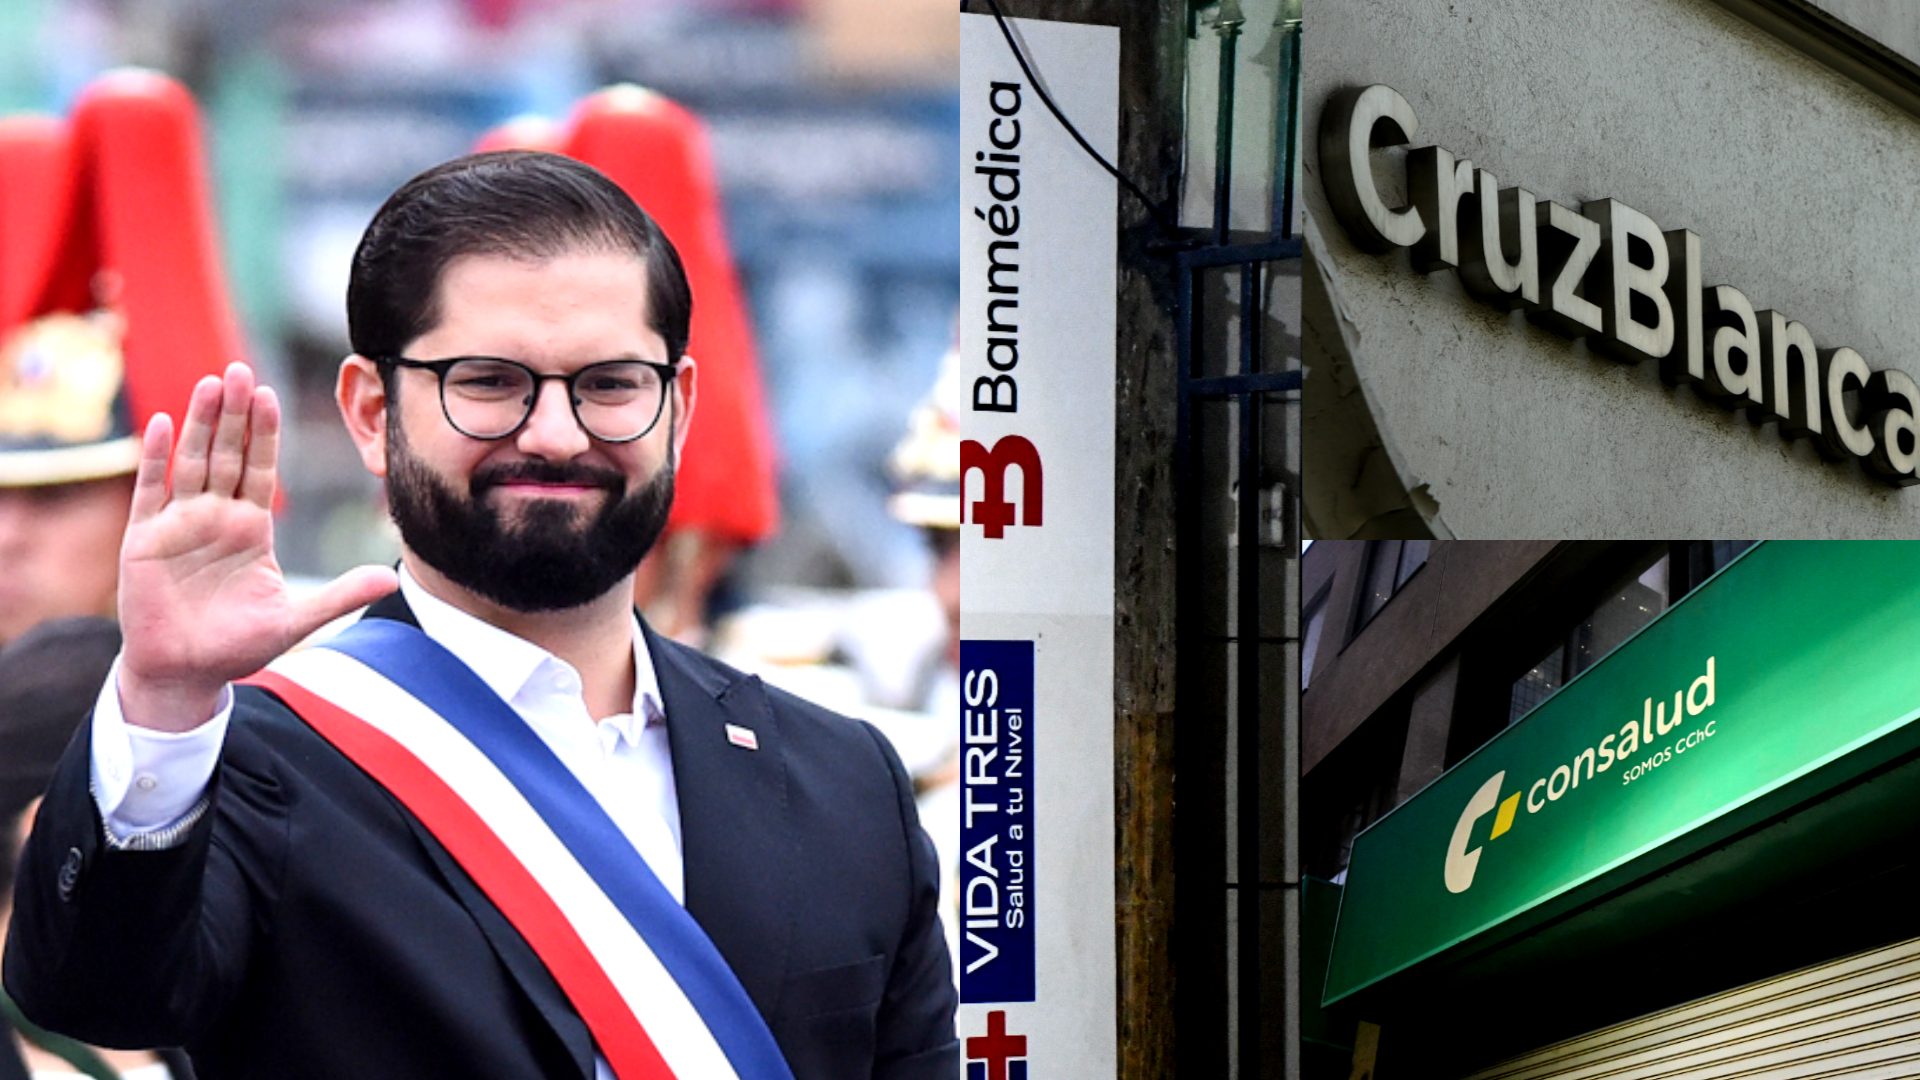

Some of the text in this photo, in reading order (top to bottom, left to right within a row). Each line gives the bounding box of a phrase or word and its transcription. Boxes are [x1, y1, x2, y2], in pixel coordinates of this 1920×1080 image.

[972, 80, 1022, 413] Banmédica
[1319, 83, 1920, 486] CruzBlanca
[1526, 655, 1716, 814] consalud
[1622, 720, 1717, 786] SOMOS CChC
[964, 668, 999, 975] VIDA TRES
[1005, 787, 1024, 816] tu
[1009, 824, 1025, 841] a
[1005, 850, 1025, 929] Salud
